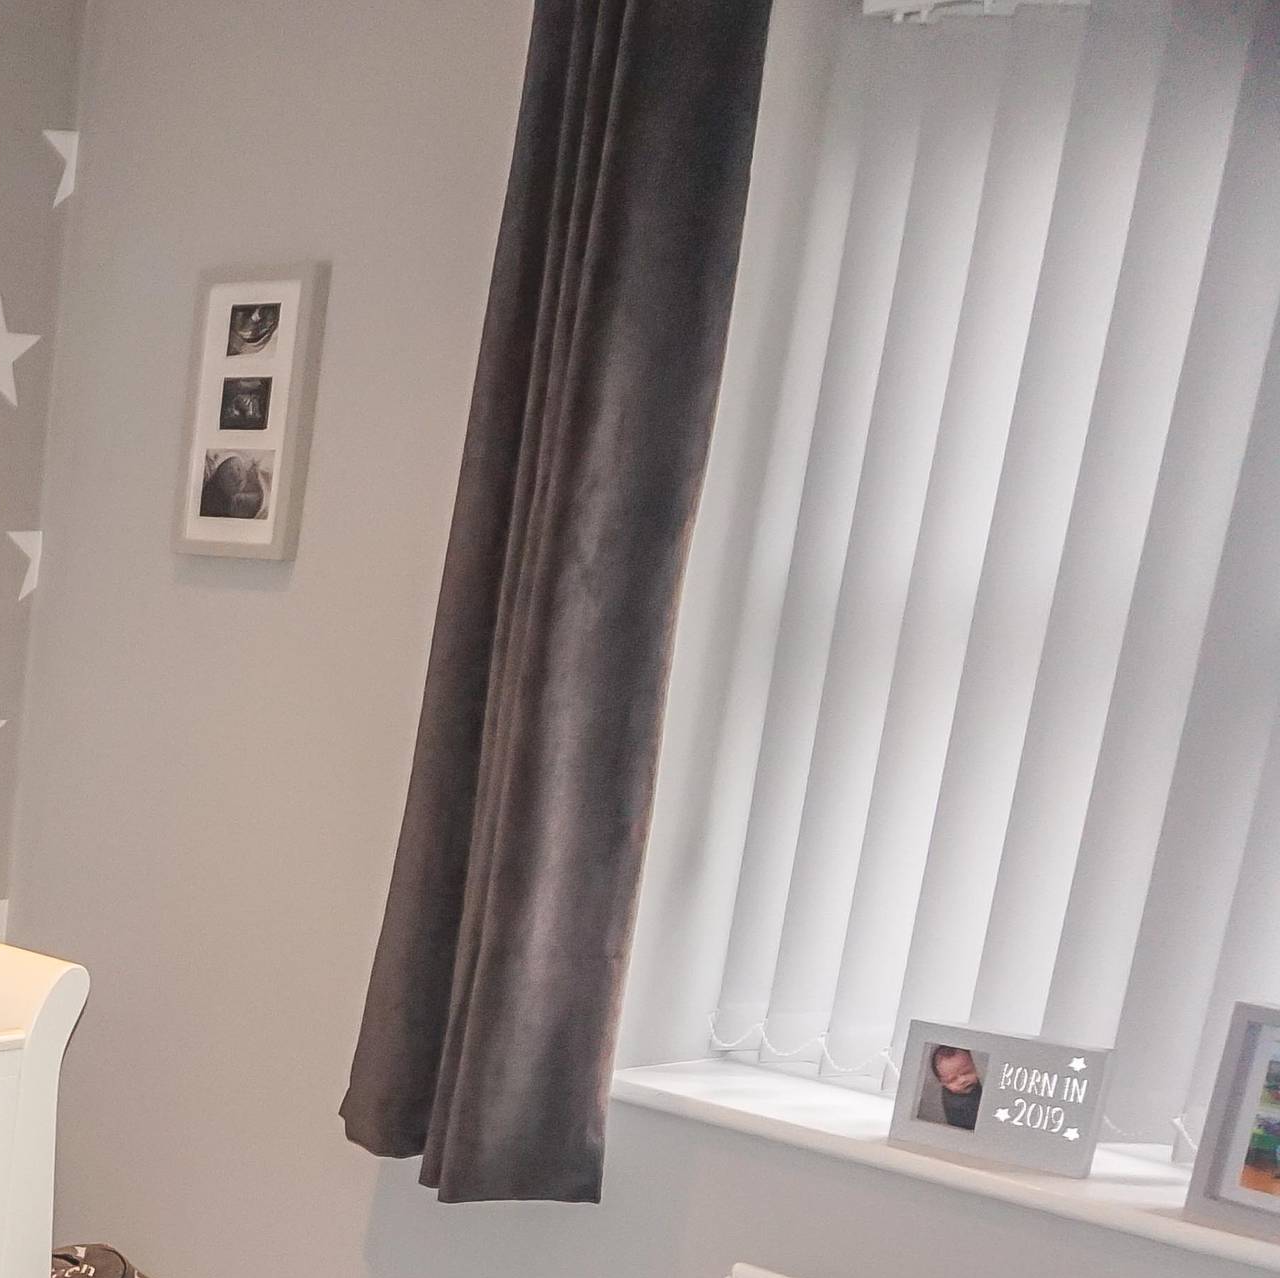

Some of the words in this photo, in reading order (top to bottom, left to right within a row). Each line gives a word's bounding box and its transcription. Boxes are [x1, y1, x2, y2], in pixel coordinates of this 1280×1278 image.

[1000, 1063, 1058, 1098] BORN
[1062, 1077, 1088, 1104] IN
[1012, 1098, 1065, 1133] 2019
